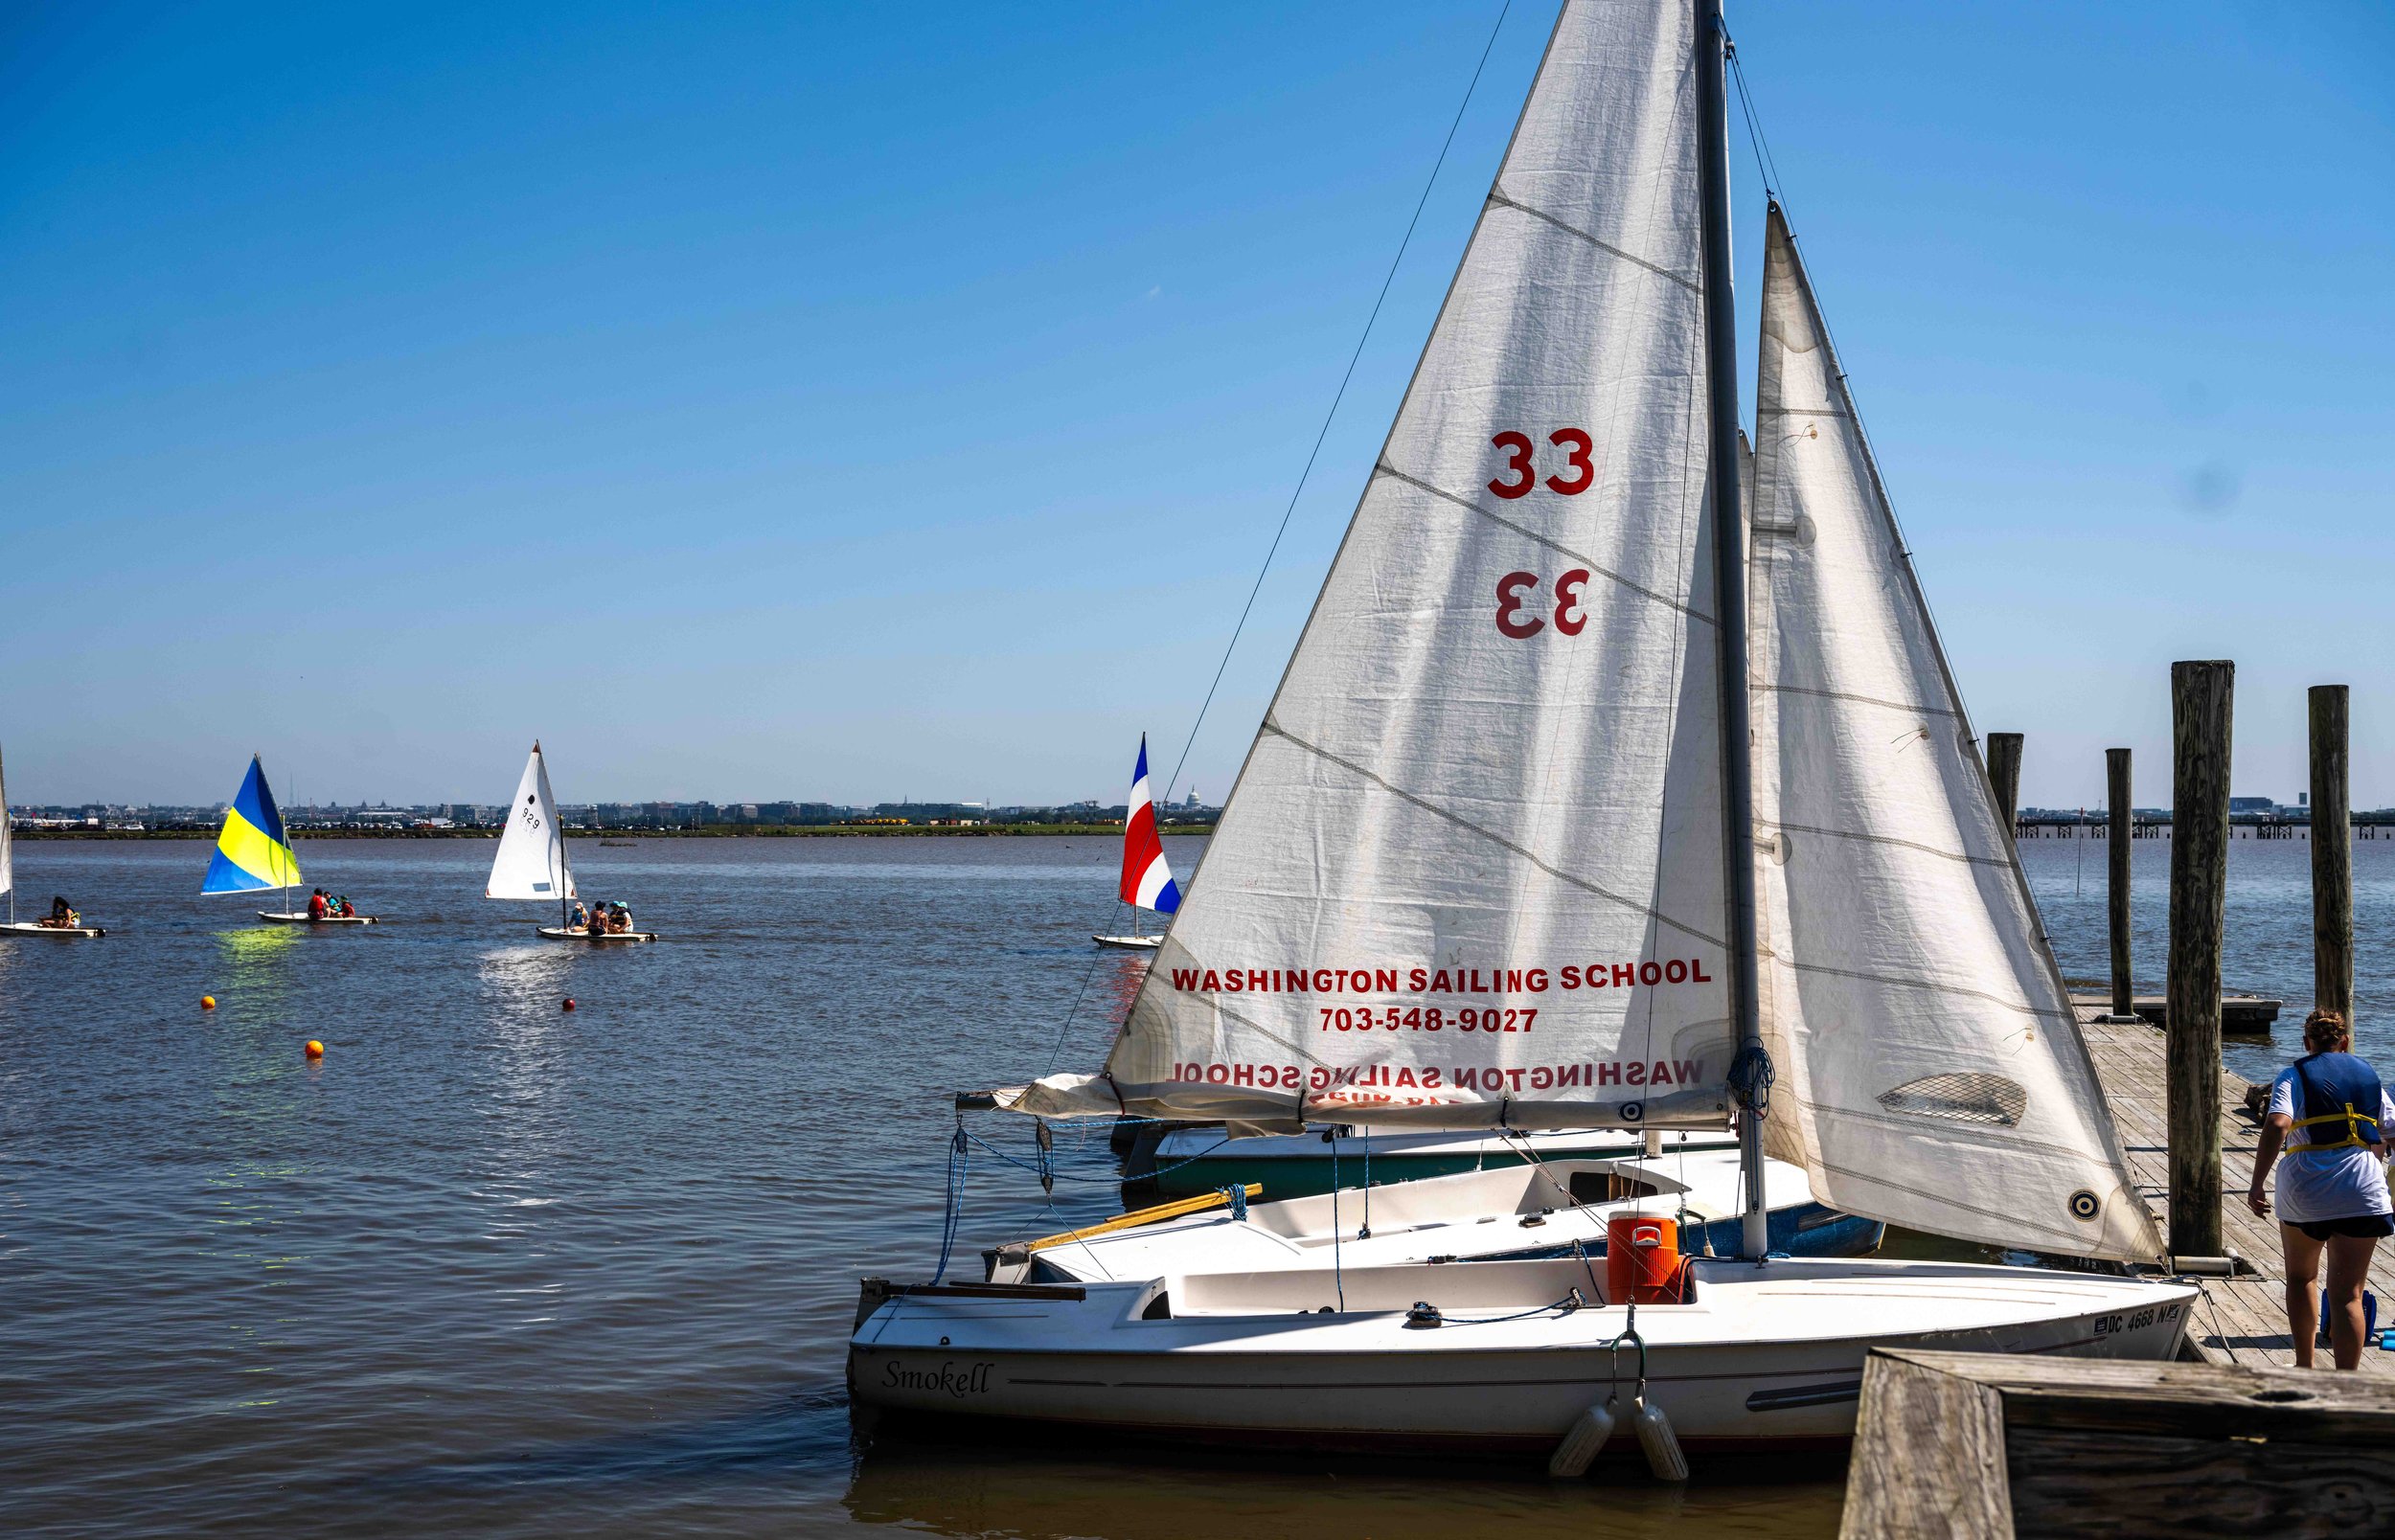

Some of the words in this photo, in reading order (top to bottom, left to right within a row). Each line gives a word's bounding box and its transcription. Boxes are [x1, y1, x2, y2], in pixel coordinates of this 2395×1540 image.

[1487, 427, 1595, 499] 33
[522, 807, 540, 829] 929
[1172, 968, 1398, 993] WASHINGTON
[1408, 967, 1549, 993] SAILING
[1561, 959, 1712, 990] SCHOOL
[1319, 1008, 1538, 1032] 703-548-9027
[2108, 1315, 2123, 1333] DC
[2128, 1309, 2155, 1332] 4668
[881, 1360, 995, 1398] Smokell
